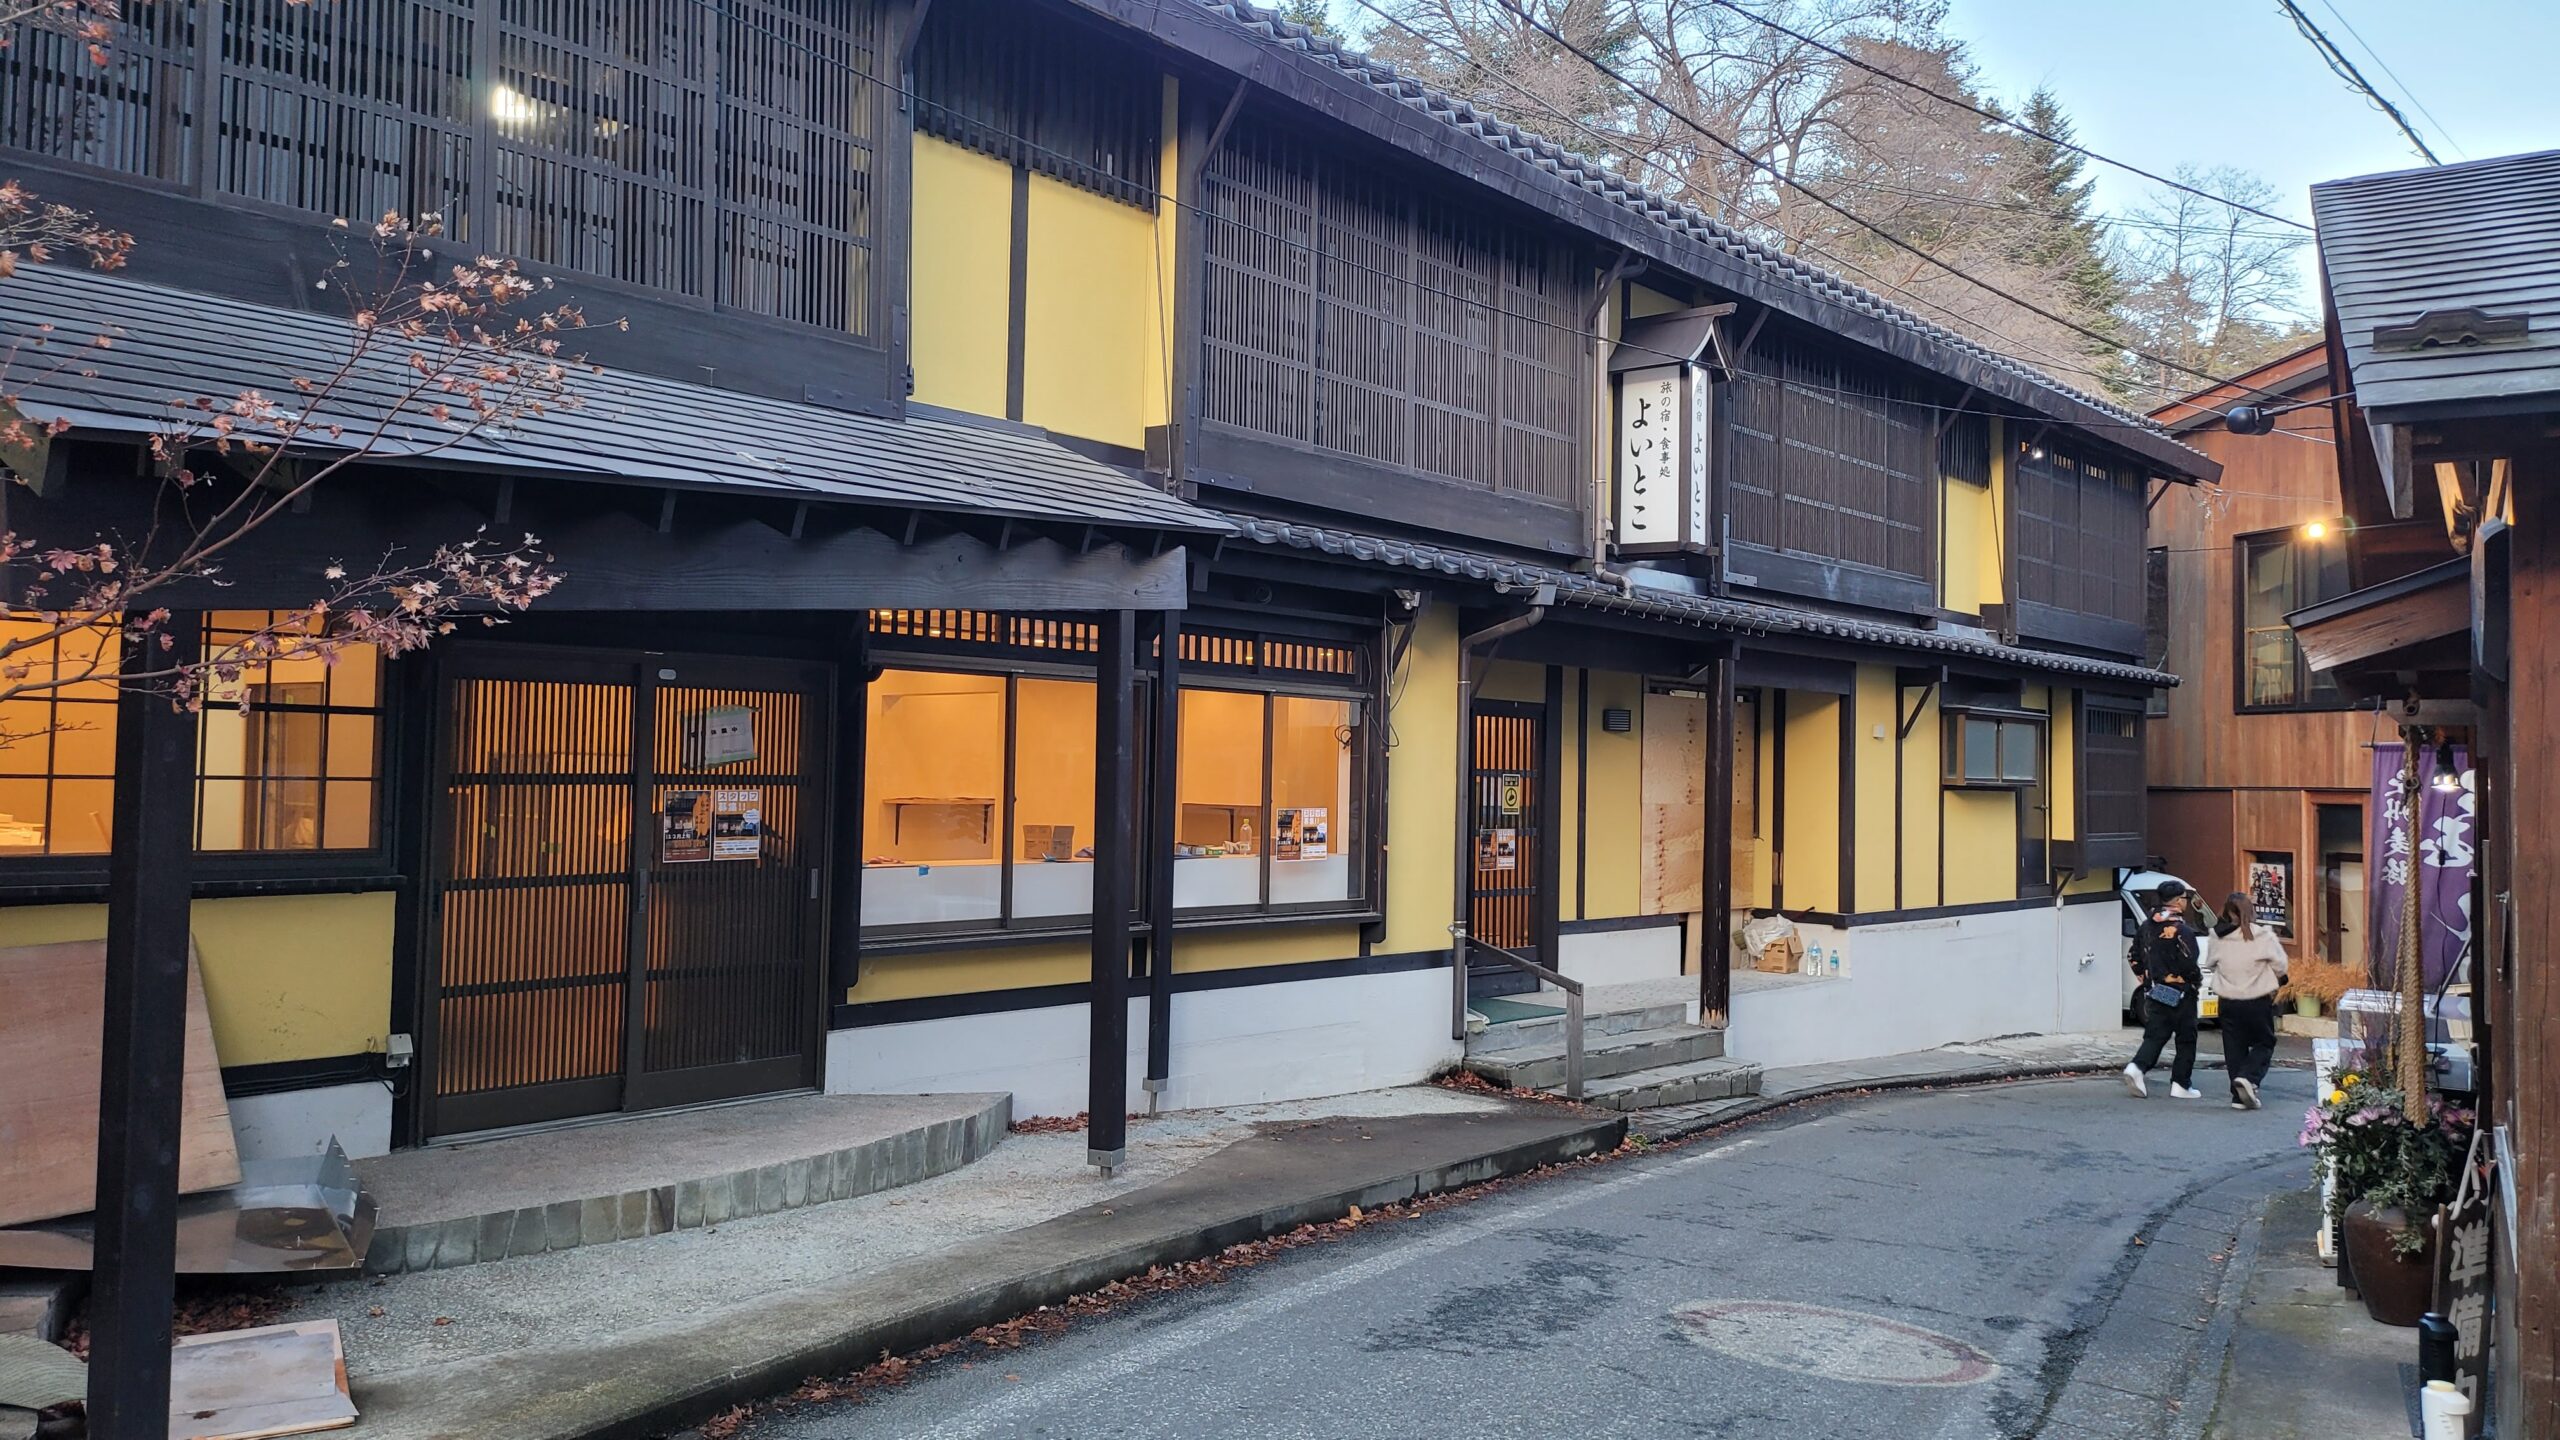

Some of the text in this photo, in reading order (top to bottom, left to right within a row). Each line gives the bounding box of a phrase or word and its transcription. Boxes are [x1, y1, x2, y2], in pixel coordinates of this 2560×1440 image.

[1630, 398, 1653, 530] よいとこ
[1659, 381, 1672, 478] 旅の宿・食事処
[1693, 432, 1704, 530] よいとこ
